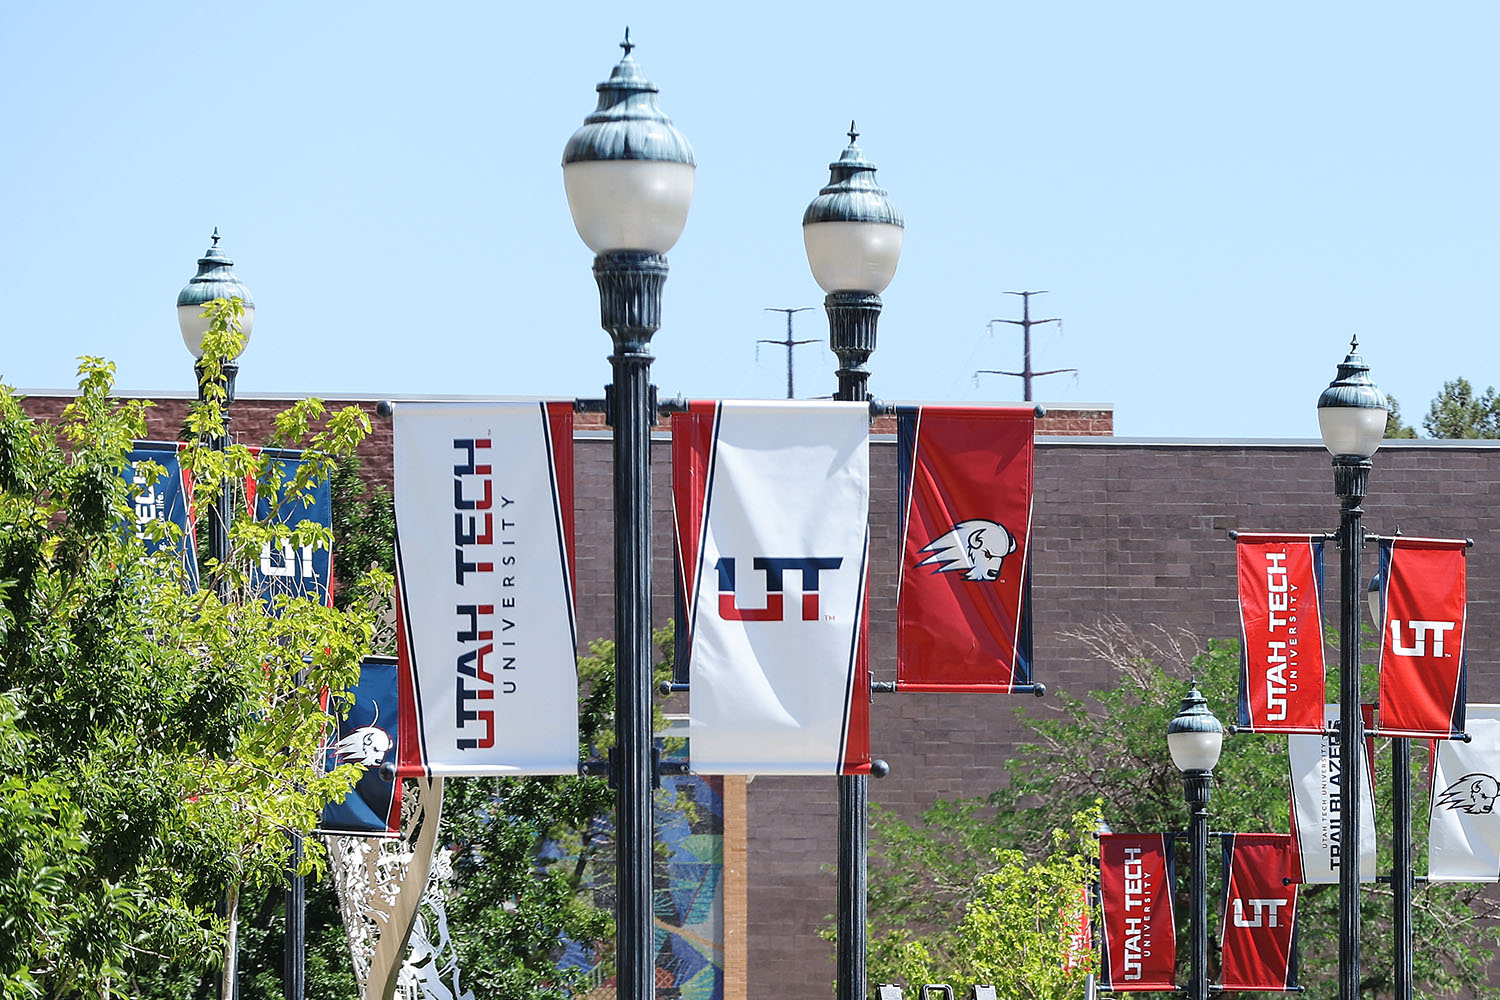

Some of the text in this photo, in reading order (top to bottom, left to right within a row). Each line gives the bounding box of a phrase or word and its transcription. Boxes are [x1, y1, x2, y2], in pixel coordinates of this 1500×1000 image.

[453, 439, 494, 751] UTAH TECH
[502, 496, 516, 693] UNIVERSITY
[714, 557, 843, 621] UT
[1265, 552, 1288, 721] UTAH TECH
[1289, 584, 1298, 692] UNIVERSITY
[1390, 619, 1455, 658] UT
[1124, 847, 1143, 981] UTAH TECH
[1232, 899, 1288, 928] UT
